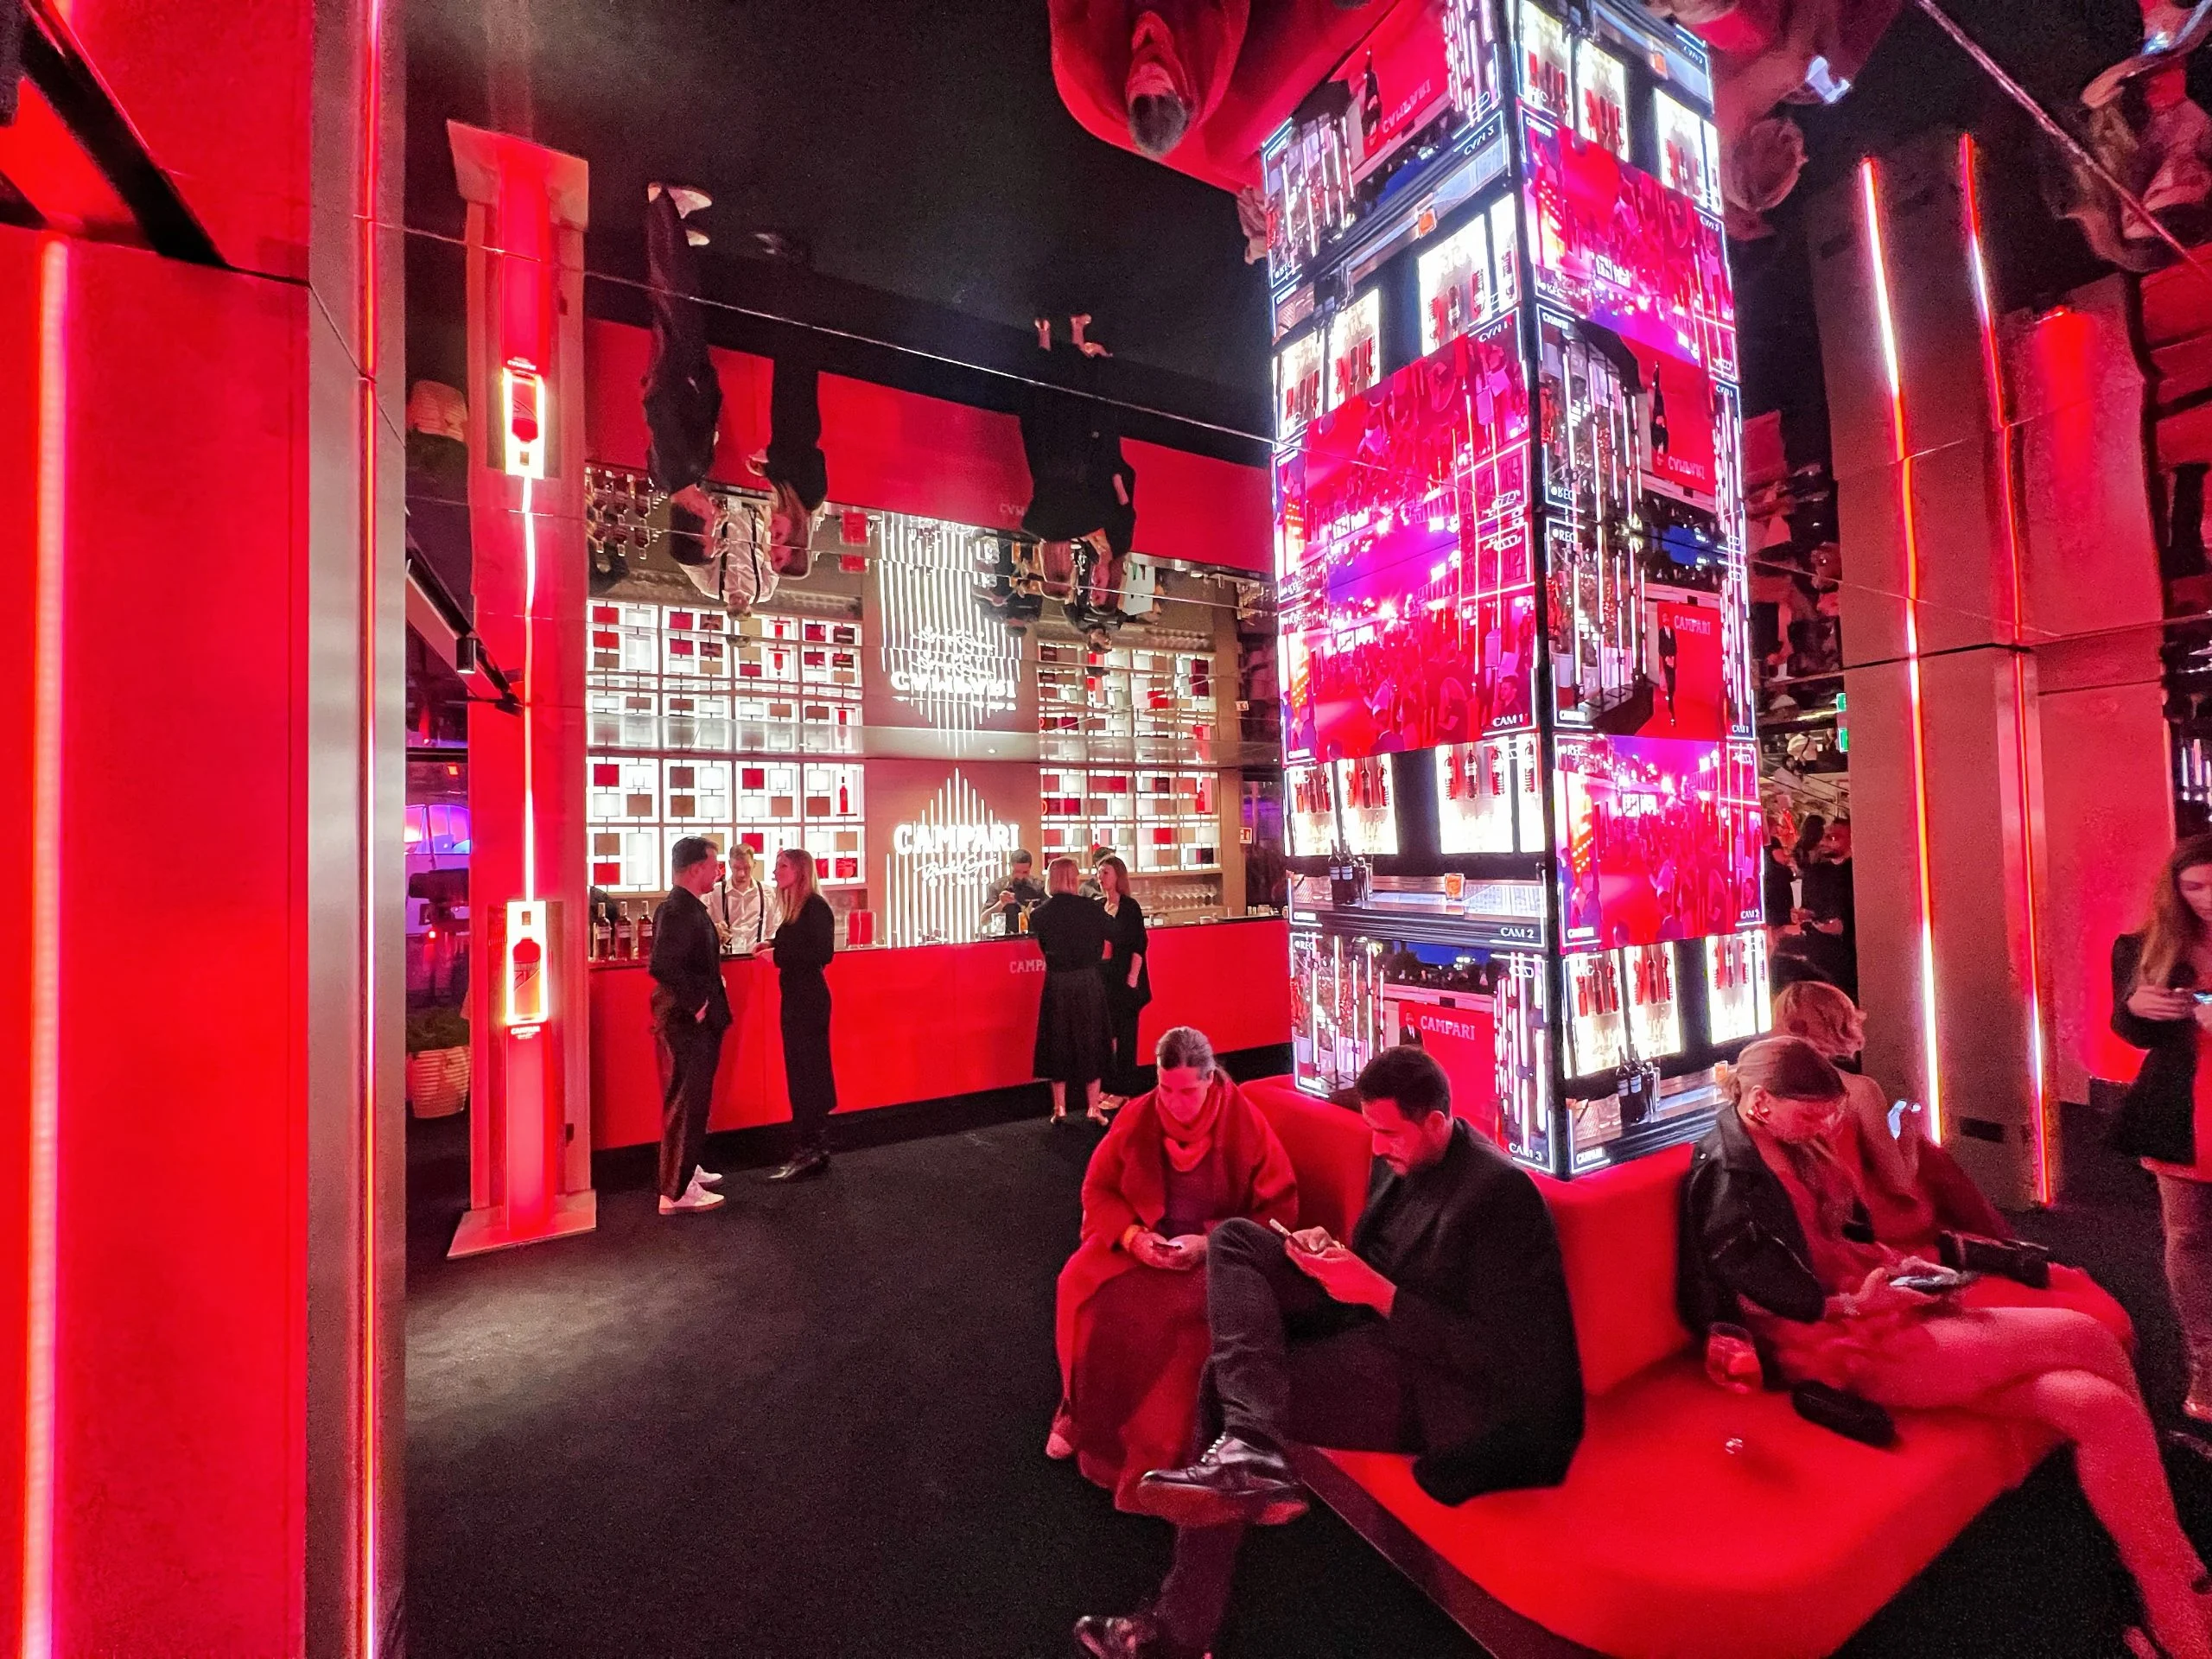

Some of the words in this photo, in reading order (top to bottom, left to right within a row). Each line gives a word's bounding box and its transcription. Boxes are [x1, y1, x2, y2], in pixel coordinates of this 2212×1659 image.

[1674, 614, 1711, 635] CAMPARI
[1492, 715, 1517, 728] CAM
[893, 823, 1020, 855] CAMPARI
[1500, 927, 1525, 938] CAM
[1526, 928, 1535, 939] 2
[1420, 1015, 1476, 1041] CAMPARI
[1534, 1151, 1543, 1162] 3
